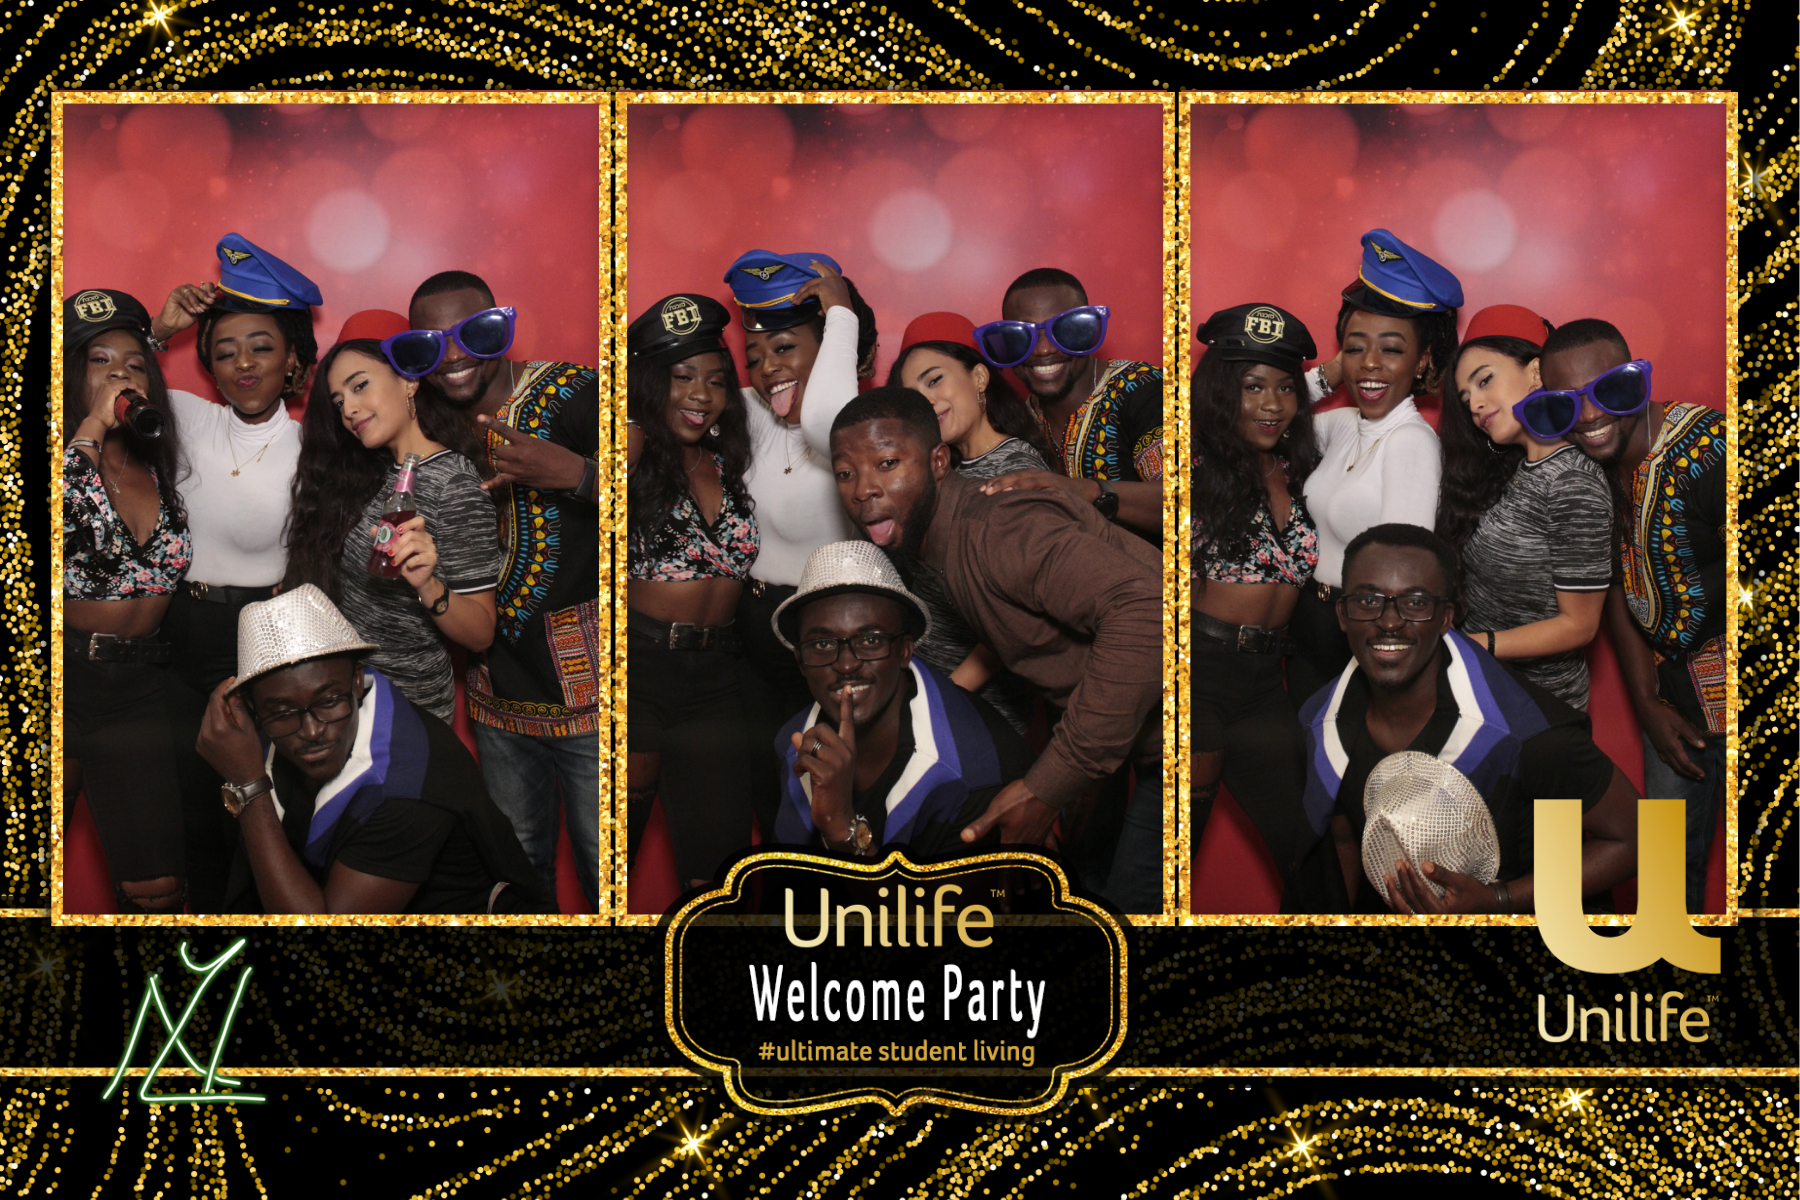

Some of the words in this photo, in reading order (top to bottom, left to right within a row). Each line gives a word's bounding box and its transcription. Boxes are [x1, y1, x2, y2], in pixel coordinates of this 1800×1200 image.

[74, 296, 118, 320] FBI
[661, 304, 702, 331] FBI
[1244, 315, 1285, 338] FBI
